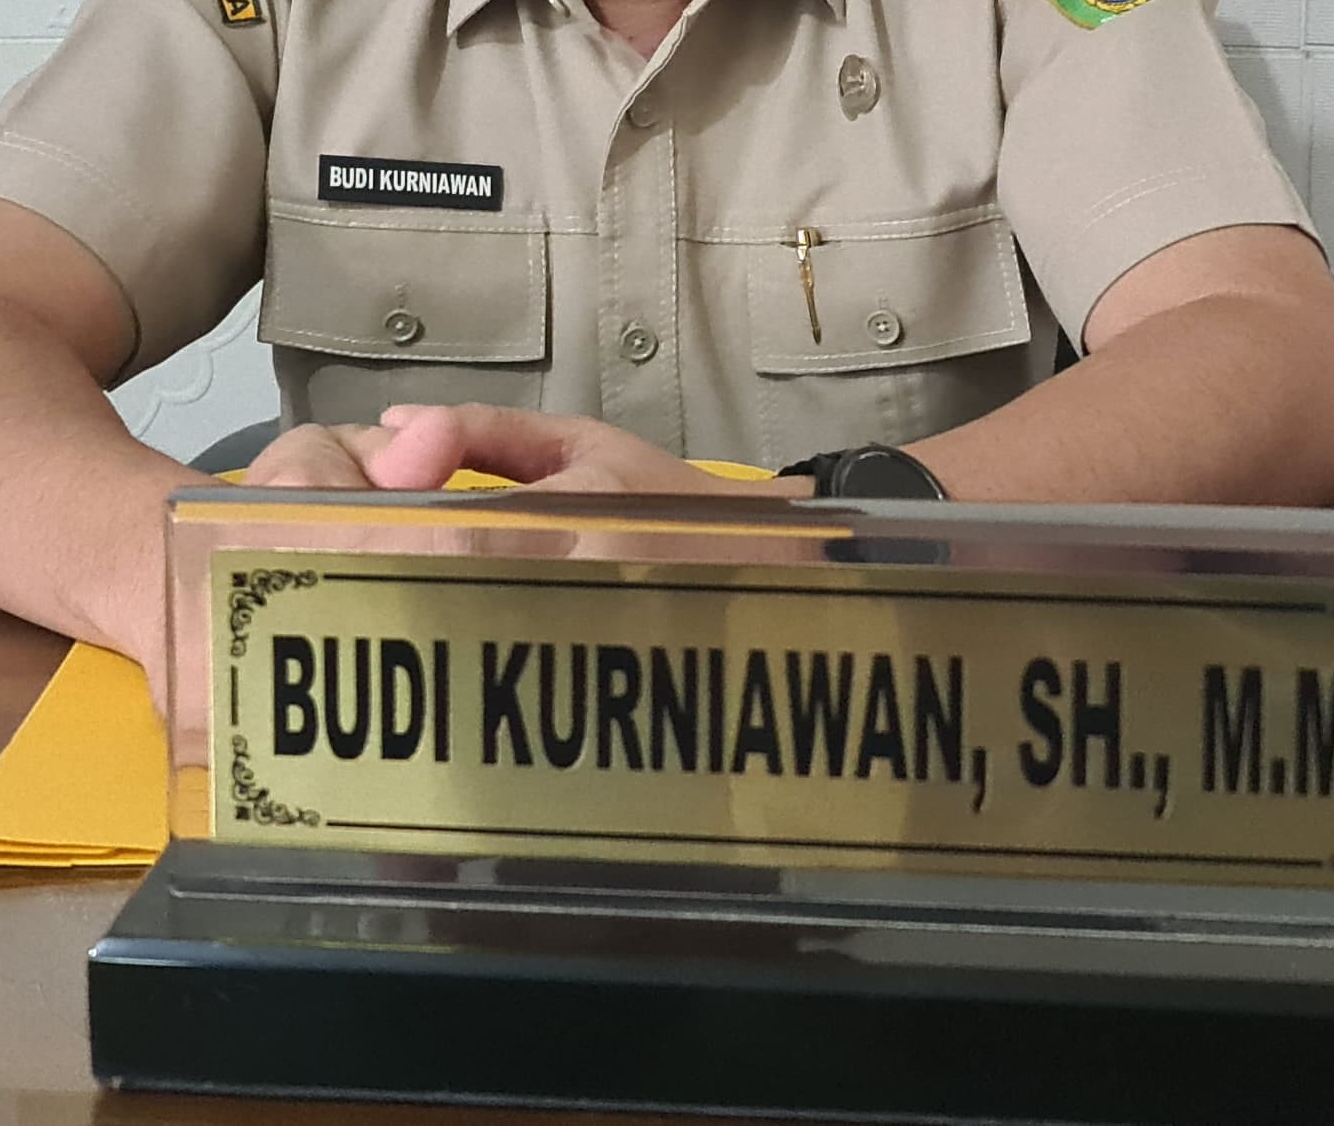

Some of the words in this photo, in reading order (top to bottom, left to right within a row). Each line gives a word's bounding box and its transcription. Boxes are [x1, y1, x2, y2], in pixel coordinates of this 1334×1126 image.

[329, 165, 374, 190] BUDI
[379, 169, 492, 197] KURNIAWAN
[272, 635, 450, 762] BUDI
[481, 641, 987, 813] KURNIAWAN,
[1018, 657, 1170, 819] SH.,
